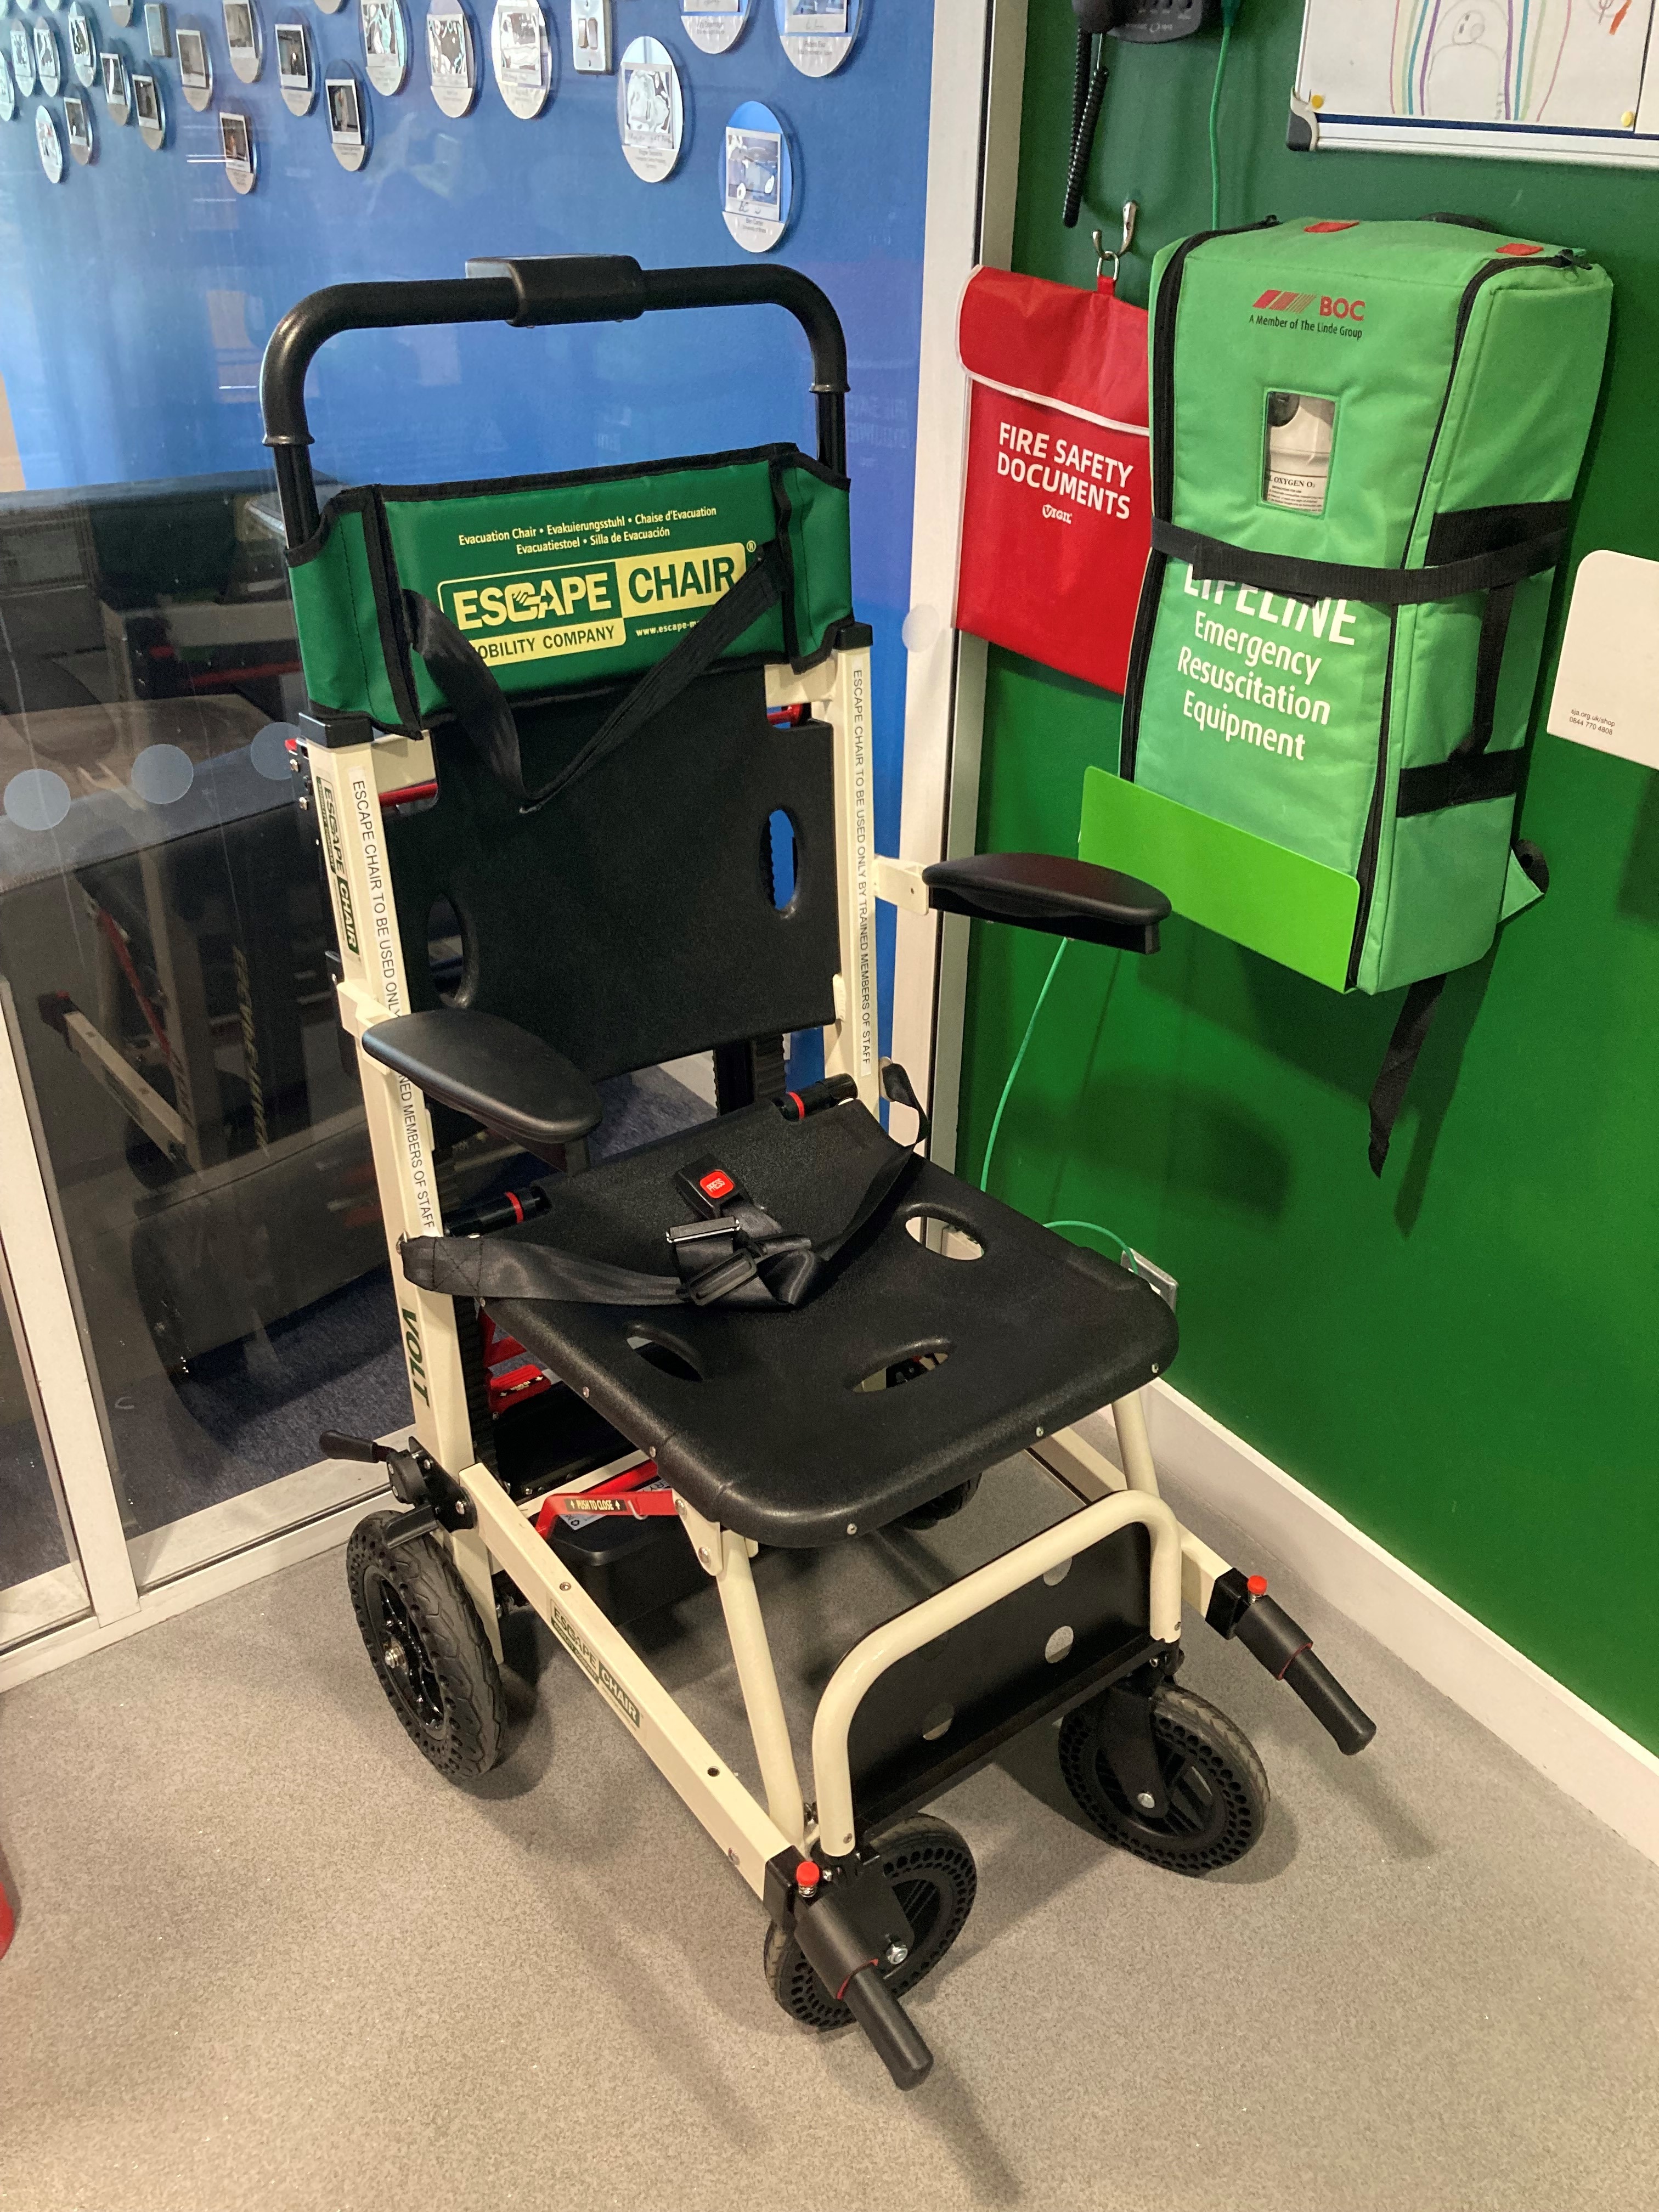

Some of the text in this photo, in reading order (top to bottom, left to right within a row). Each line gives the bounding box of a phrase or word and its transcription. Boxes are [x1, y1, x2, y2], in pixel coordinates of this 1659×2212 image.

[1319, 295, 1365, 321] BOC
[1249, 314, 1363, 341] A Member of The Linde Group
[998, 421, 1134, 488] FIRE SAFETY
[997, 451, 1131, 520] DOCUMENTS
[1274, 476, 1304, 487] OXYGEN
[459, 506, 717, 546] Evacuation Chair Evakuierungsstuhl Chaise d'Evacuation
[1042, 504, 1072, 524] VIGIL
[516, 527, 670, 555] Evacuatiestoel Silla de Evacuación
[453, 556, 736, 630] ESCAPE CHAIR
[474, 625, 614, 659] OBILITY COMPANY
[636, 620, 699, 637] www.escape-m
[1195, 610, 1323, 686] Emergency
[854, 670, 863, 723] ESCAPE
[1177, 646, 1331, 725] Resuscitation
[1183, 689, 1306, 761] Equipment
[1569, 716, 1613, 736] 0844 770 4808
[1571, 708, 1616, 727] sja.org.uk/shop
[854, 726, 864, 766] CHAIR
[855, 769, 865, 787] TO
[353, 780, 375, 841] ESCAPE
[856, 790, 865, 806] BE
[856, 810, 865, 843] USED
[324, 787, 345, 874] ESCAPE
[340, 883, 357, 947] CHAIR
[365, 844, 382, 891] CHAIR
[857, 845, 866, 878] ONLY
[373, 892, 385, 914] TO
[859, 881, 867, 896] BY
[376, 917, 390, 937] BE
[859, 899, 868, 951] TRAINED
[379, 939, 396, 979] USED
[861, 953, 870, 1010] MEMBERS
[862, 1012, 870, 1028] OF
[403, 1104, 422, 1169] MEMBERS
[414, 1171, 427, 1187] OF
[706, 1178, 725, 1193] PRESS
[417, 1190, 435, 1228] STAFF
[402, 1308, 430, 1408] VOLT
[575, 1499, 614, 1510] PUSH TO CLOSE
[554, 1606, 596, 1669] ESCAPE
[601, 1669, 637, 1720] CHAIR
